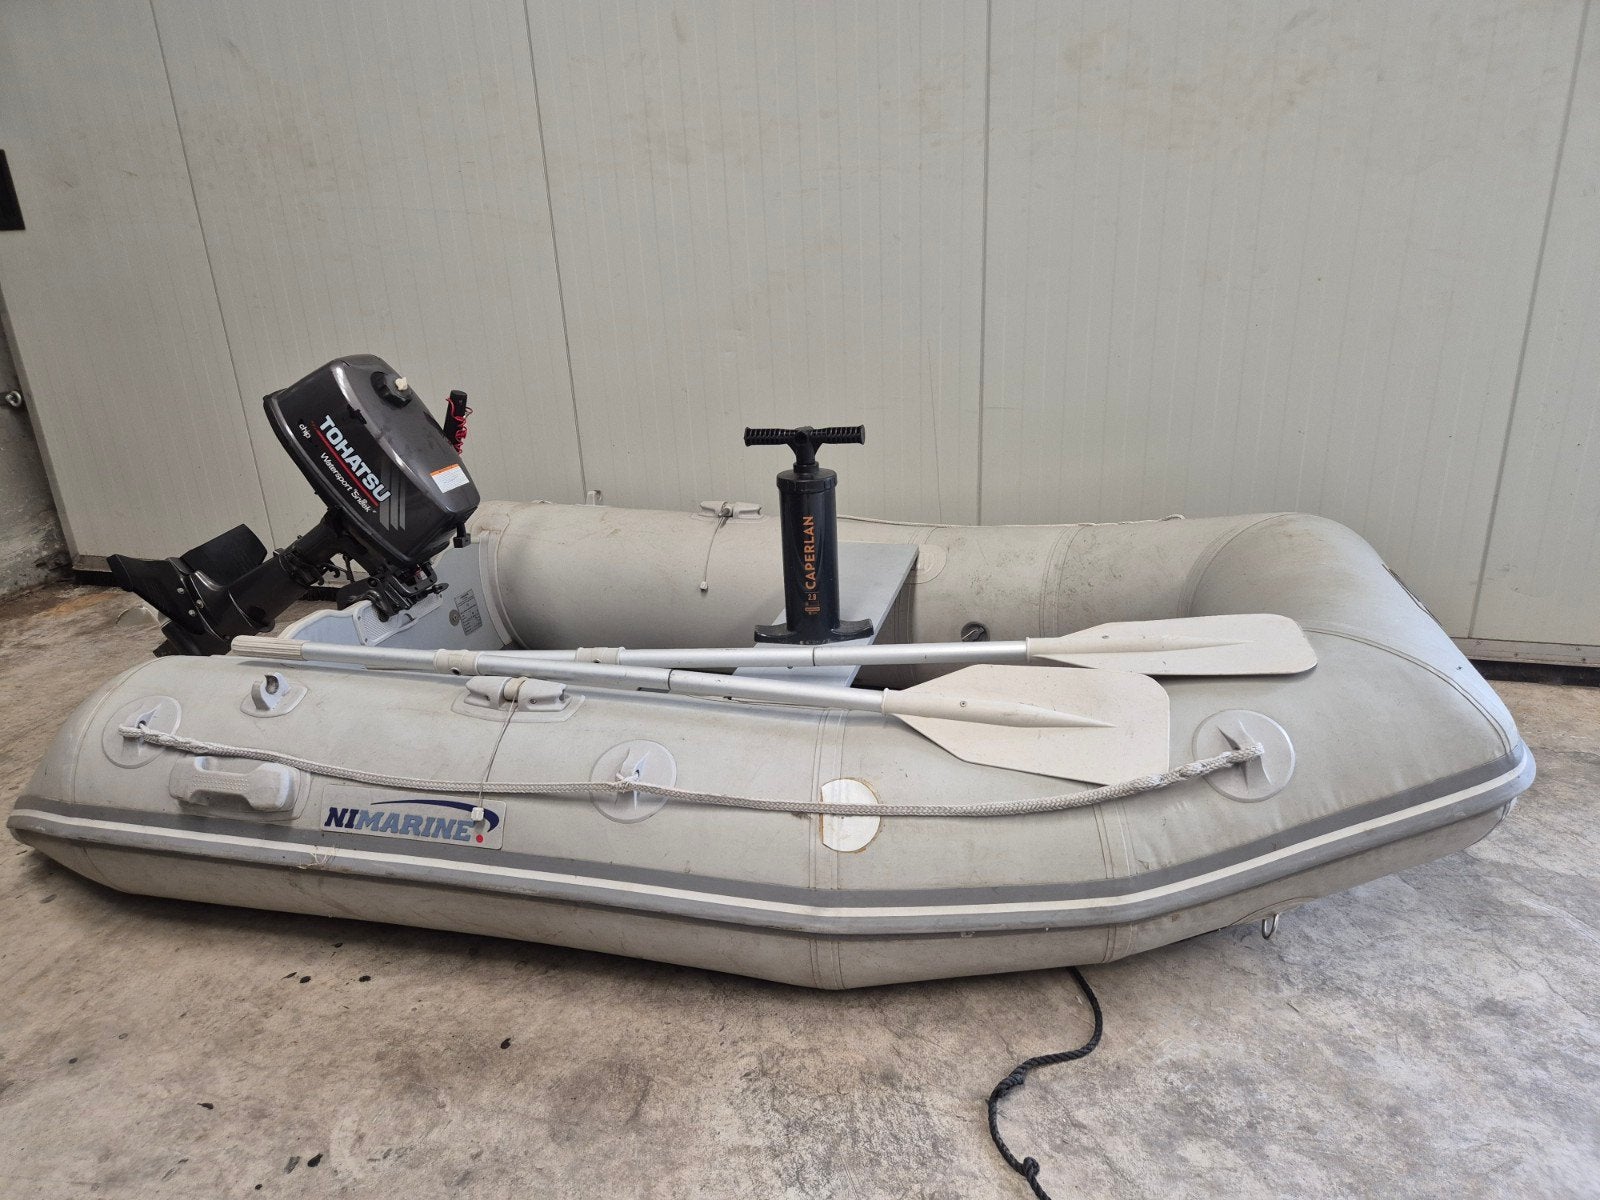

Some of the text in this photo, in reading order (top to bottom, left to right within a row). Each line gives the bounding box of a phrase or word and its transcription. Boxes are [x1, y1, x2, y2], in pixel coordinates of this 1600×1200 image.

[299, 423, 311, 439] chip
[319, 415, 392, 502] TOHATSU
[320, 452, 353, 492] Watersport
[803, 516, 817, 590] CAPERLAN
[324, 806, 475, 842] NIMARINE
